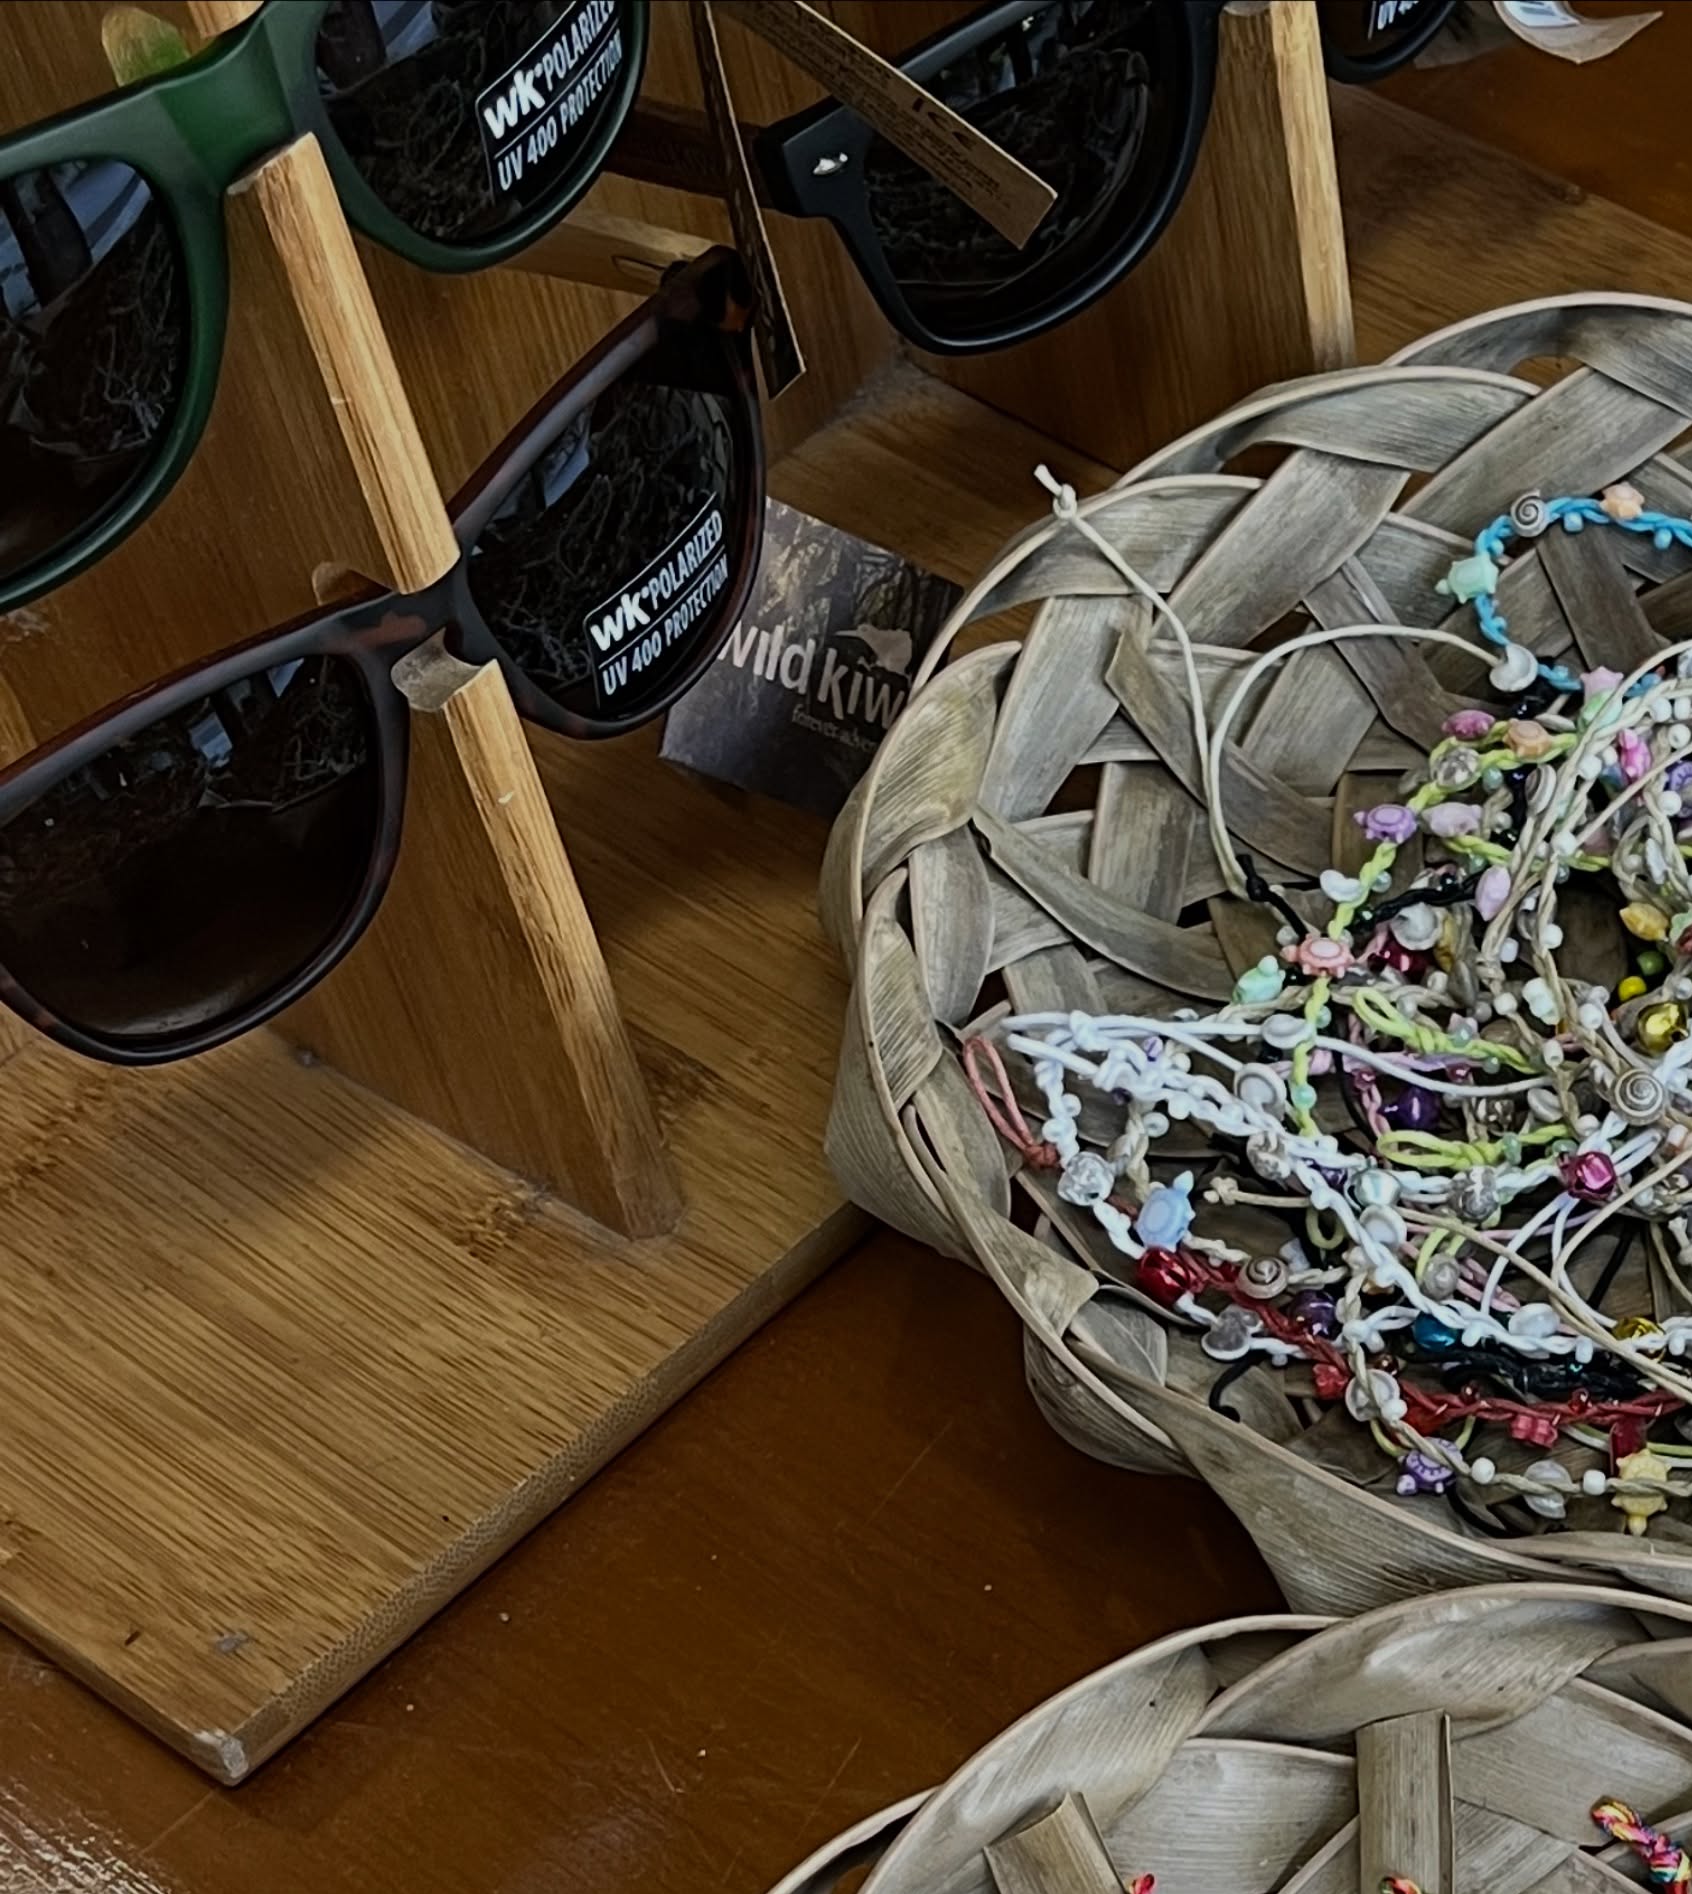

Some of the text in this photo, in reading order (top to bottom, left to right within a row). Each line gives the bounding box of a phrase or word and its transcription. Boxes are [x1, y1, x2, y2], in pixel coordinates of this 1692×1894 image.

[498, 28, 622, 191] UV 400 PROTECTION
[648, 509, 723, 610] POLARIZED
[602, 553, 728, 695] UV 400 PROTECTION
[817, 648, 906, 730] kiw
